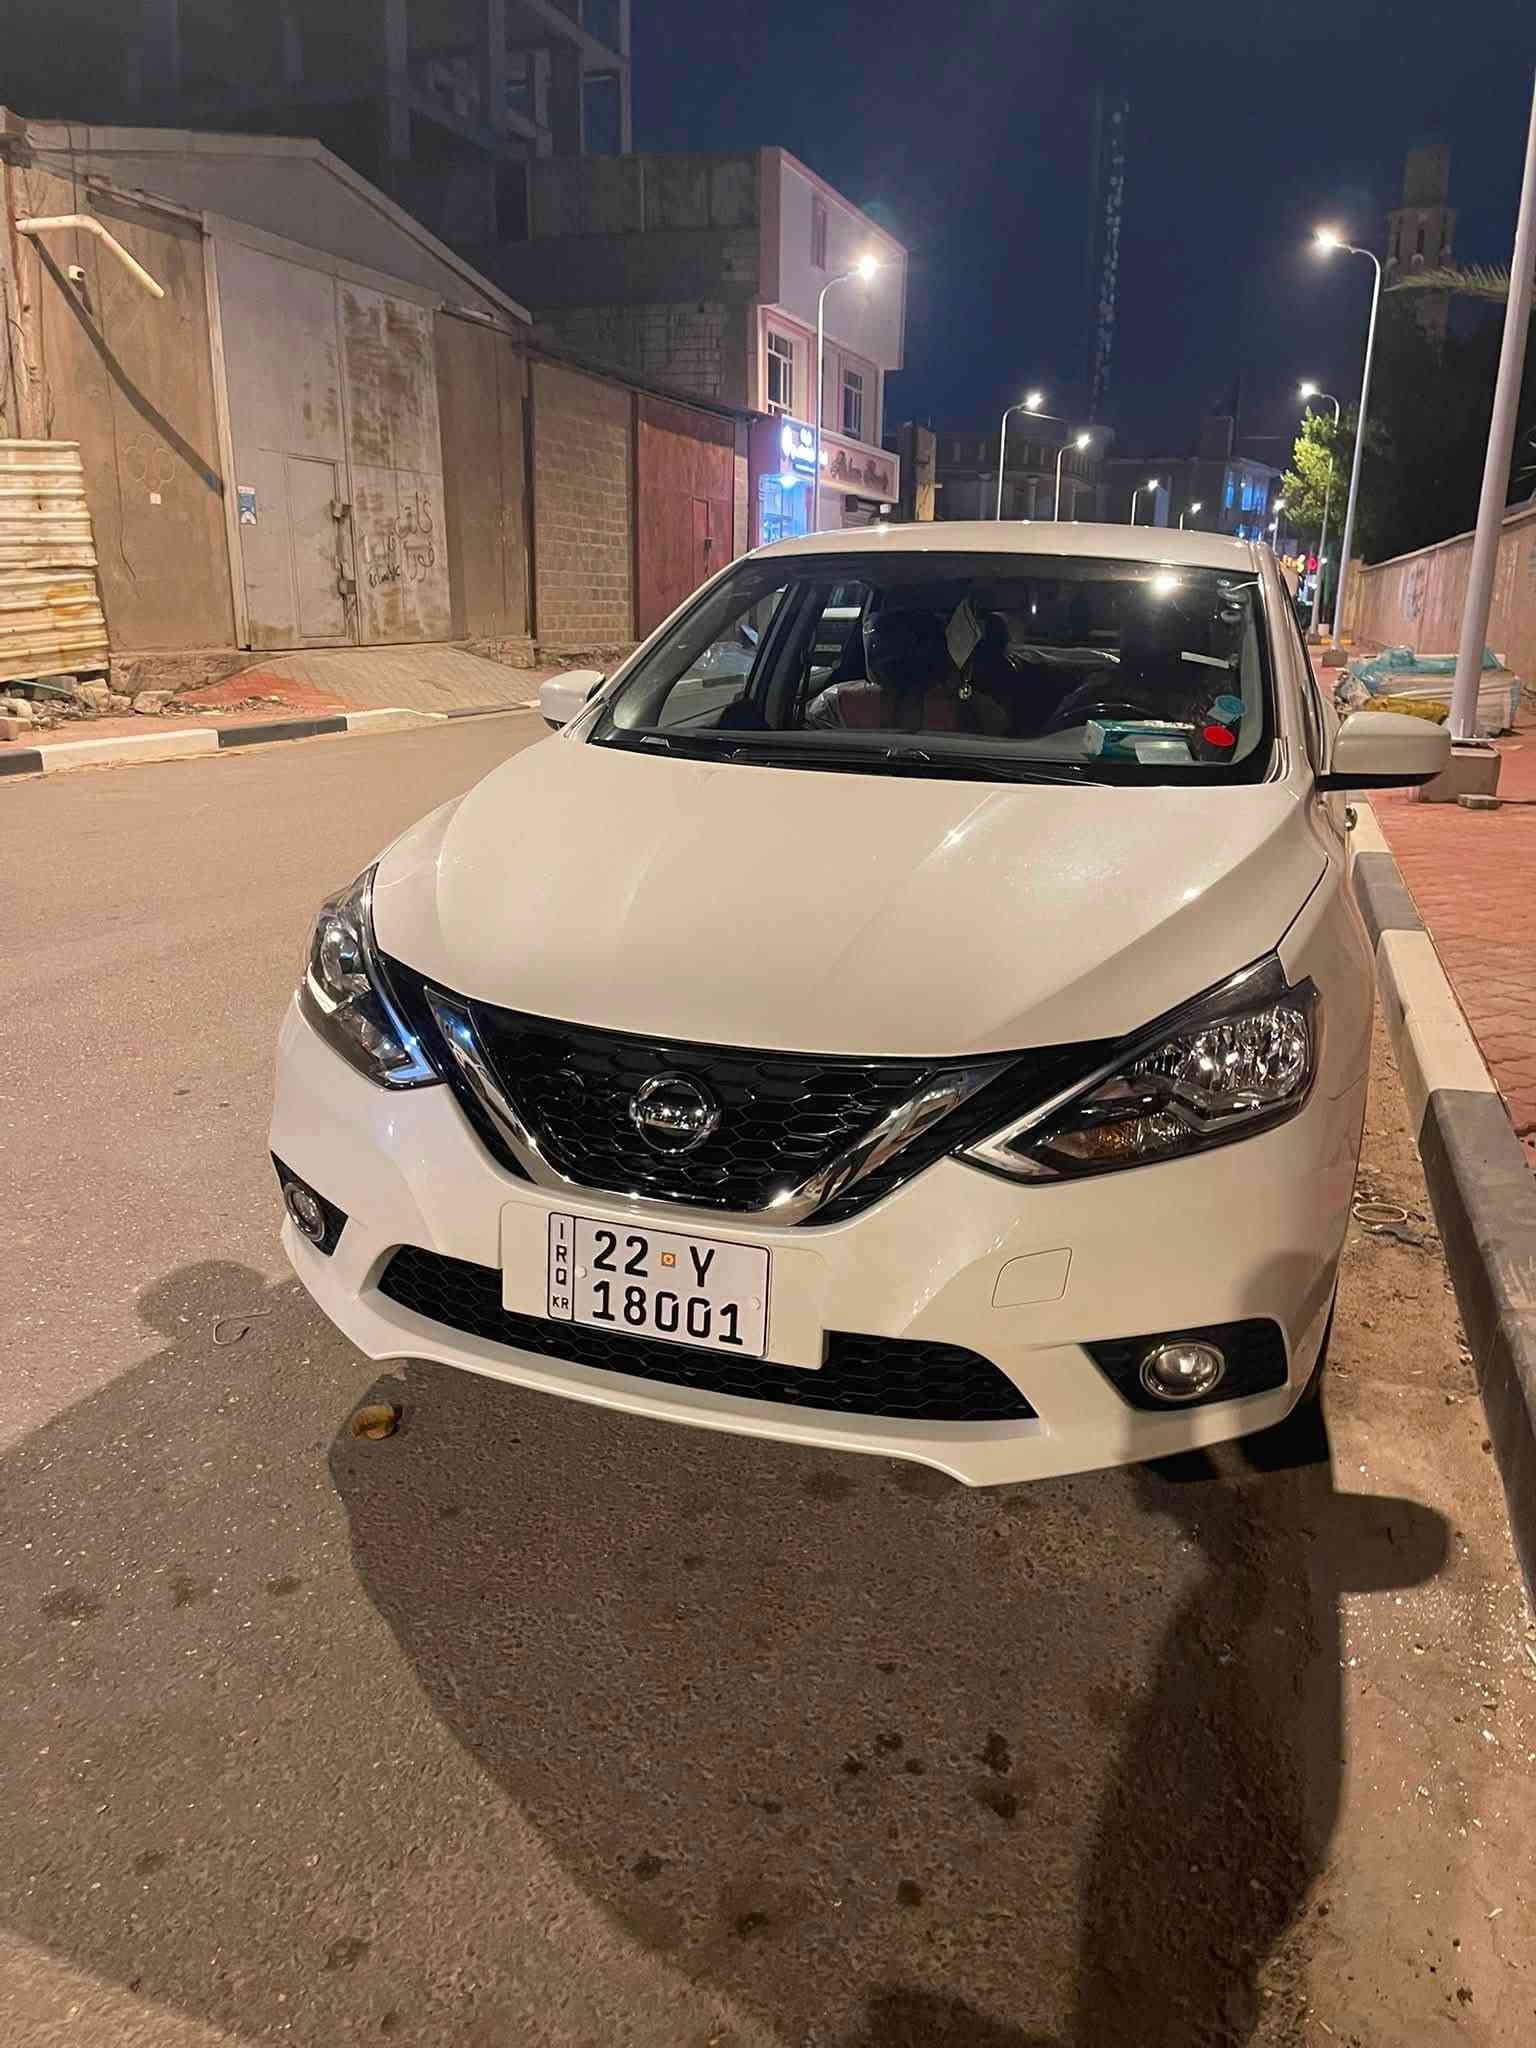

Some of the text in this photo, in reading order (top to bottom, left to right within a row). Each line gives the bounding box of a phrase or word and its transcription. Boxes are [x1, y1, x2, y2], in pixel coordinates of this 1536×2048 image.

[555, 1222, 567, 1286] IRQ
[593, 1229, 715, 1288] 22 Y
[552, 1295, 569, 1310] KR
[592, 1279, 744, 1346] 18001
